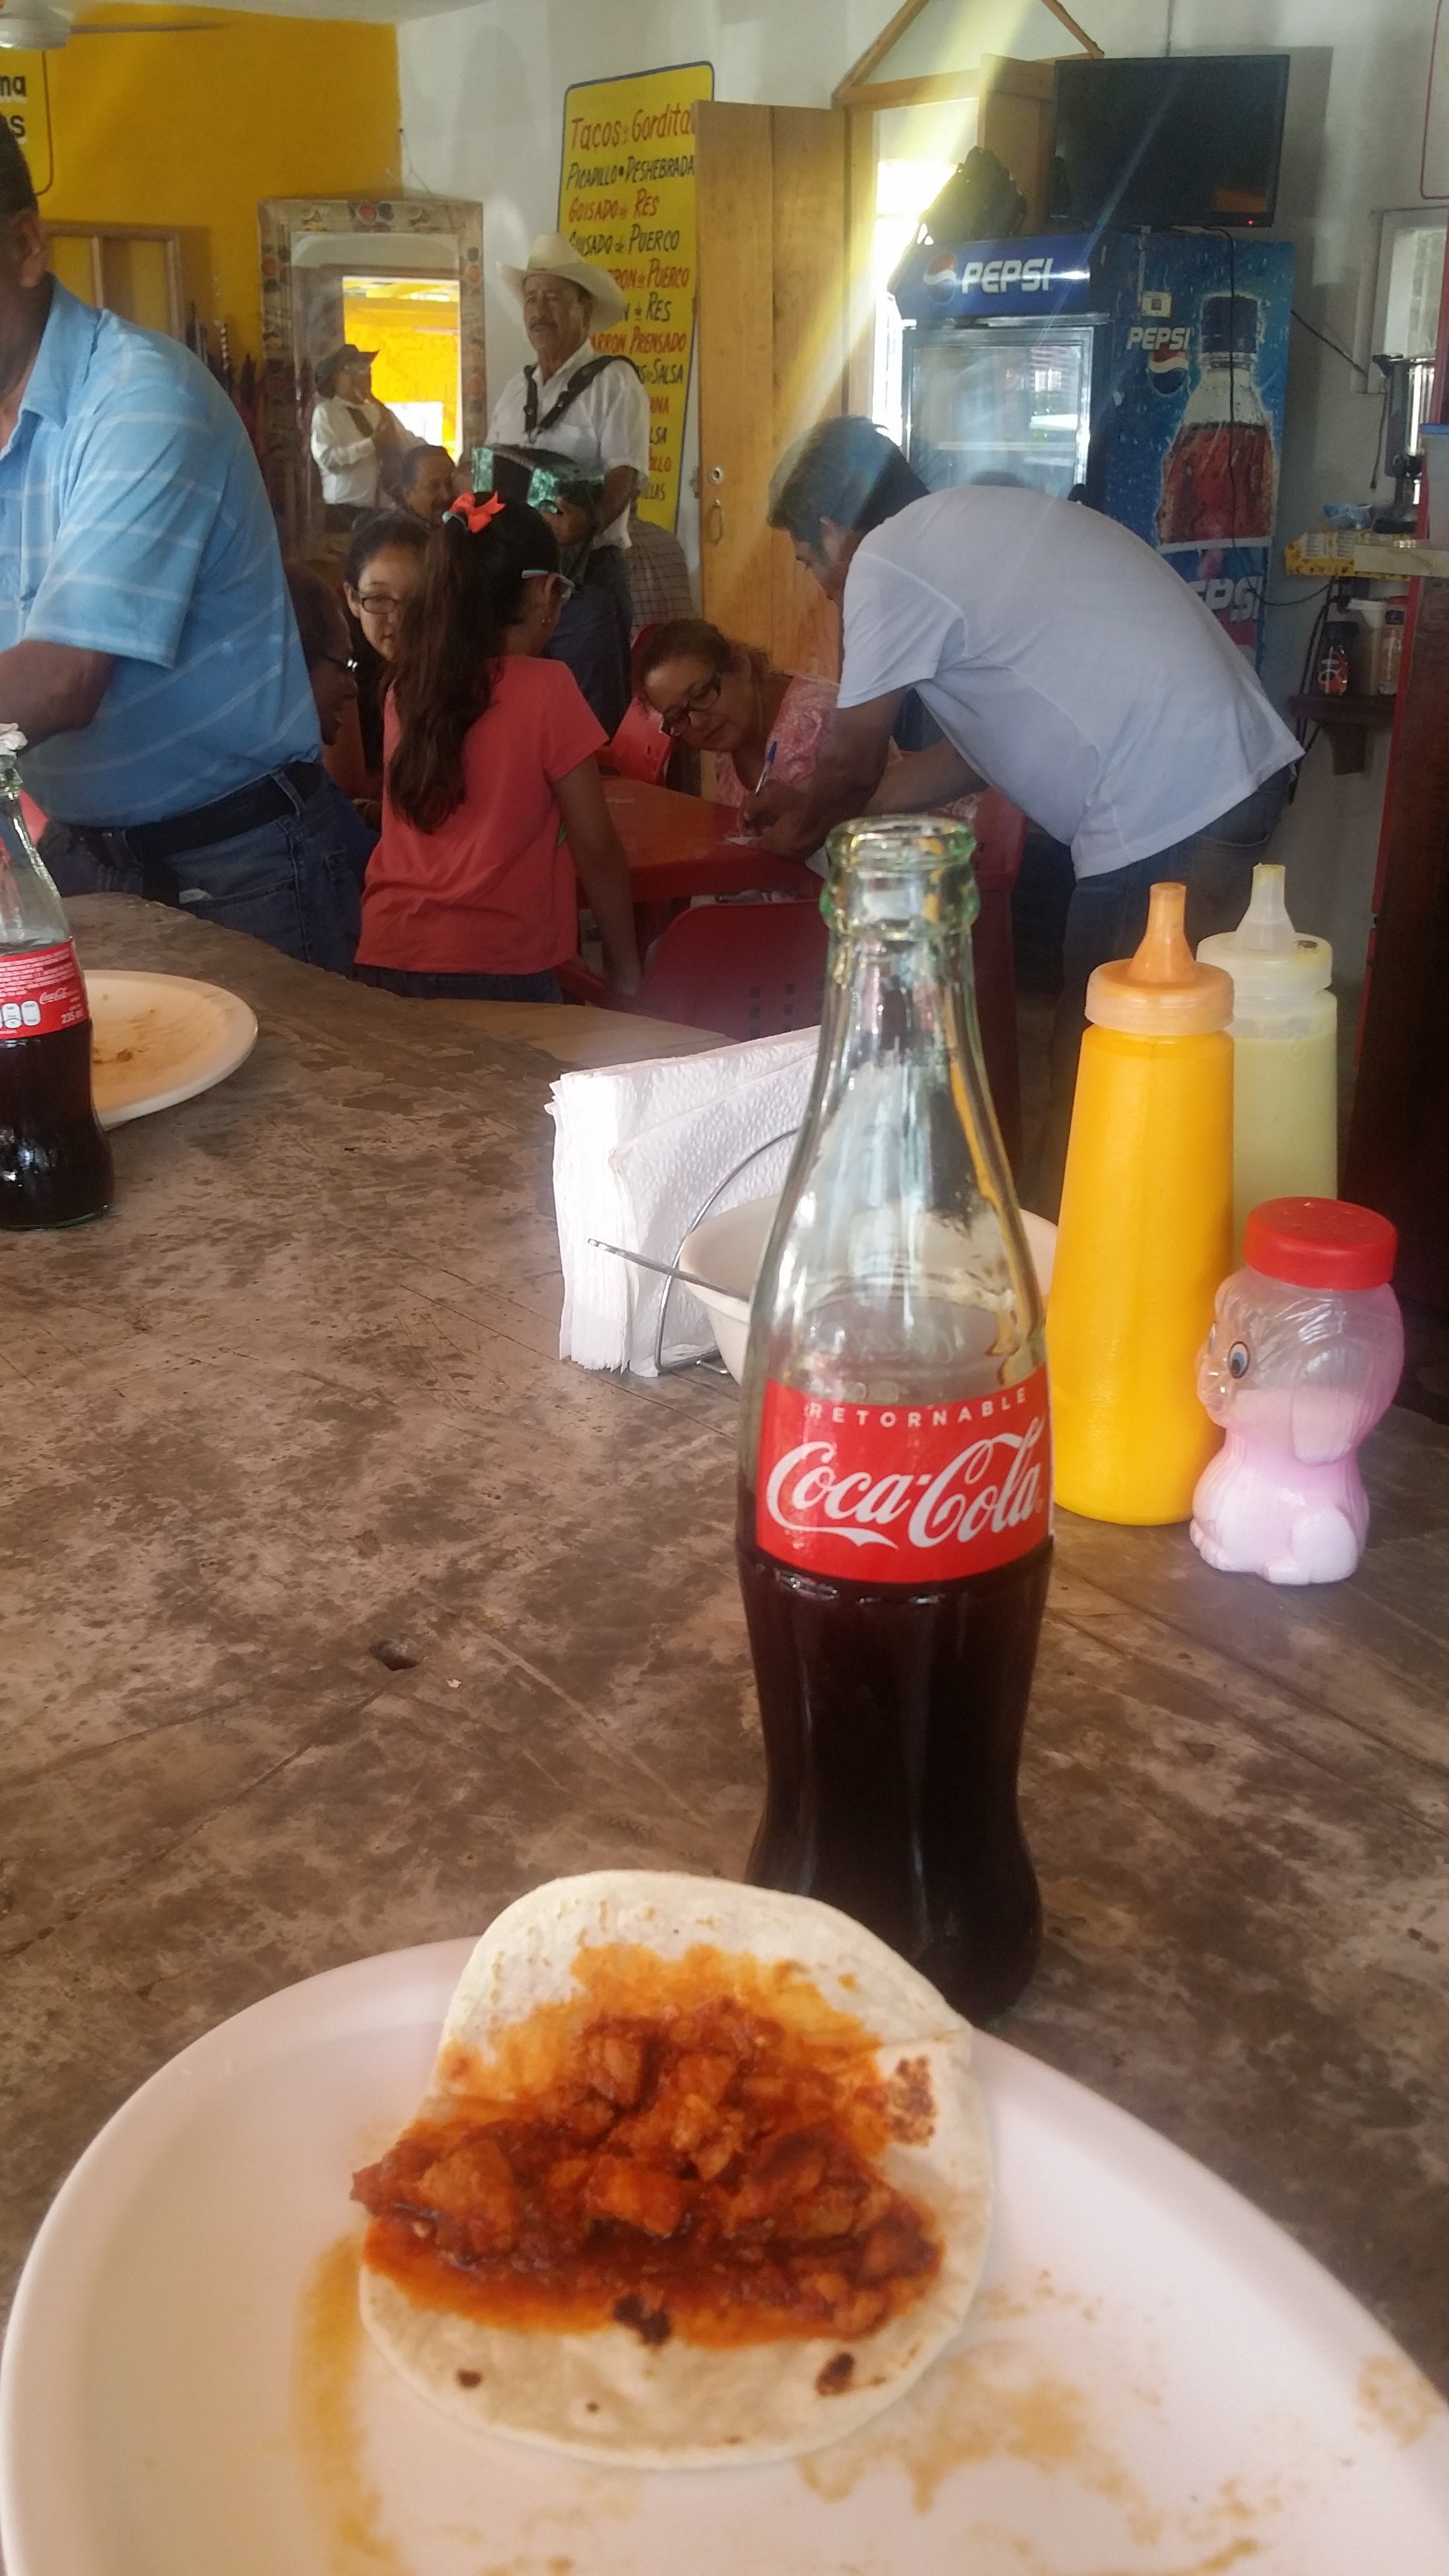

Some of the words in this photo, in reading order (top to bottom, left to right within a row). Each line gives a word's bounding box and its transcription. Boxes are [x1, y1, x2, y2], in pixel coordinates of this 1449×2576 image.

[572, 117, 622, 150] Tacos
[632, 102, 693, 142] Gordita
[628, 223, 680, 255] PUERCO
[962, 258, 1053, 294] PEPSI
[1126, 326, 1191, 351] PEPSI
[651, 358, 683, 384] SALSA
[649, 427, 668, 445] LSA
[804, 1387, 1027, 1428] RETORNABLE
[766, 1415, 1045, 1550] Coca-Cola
